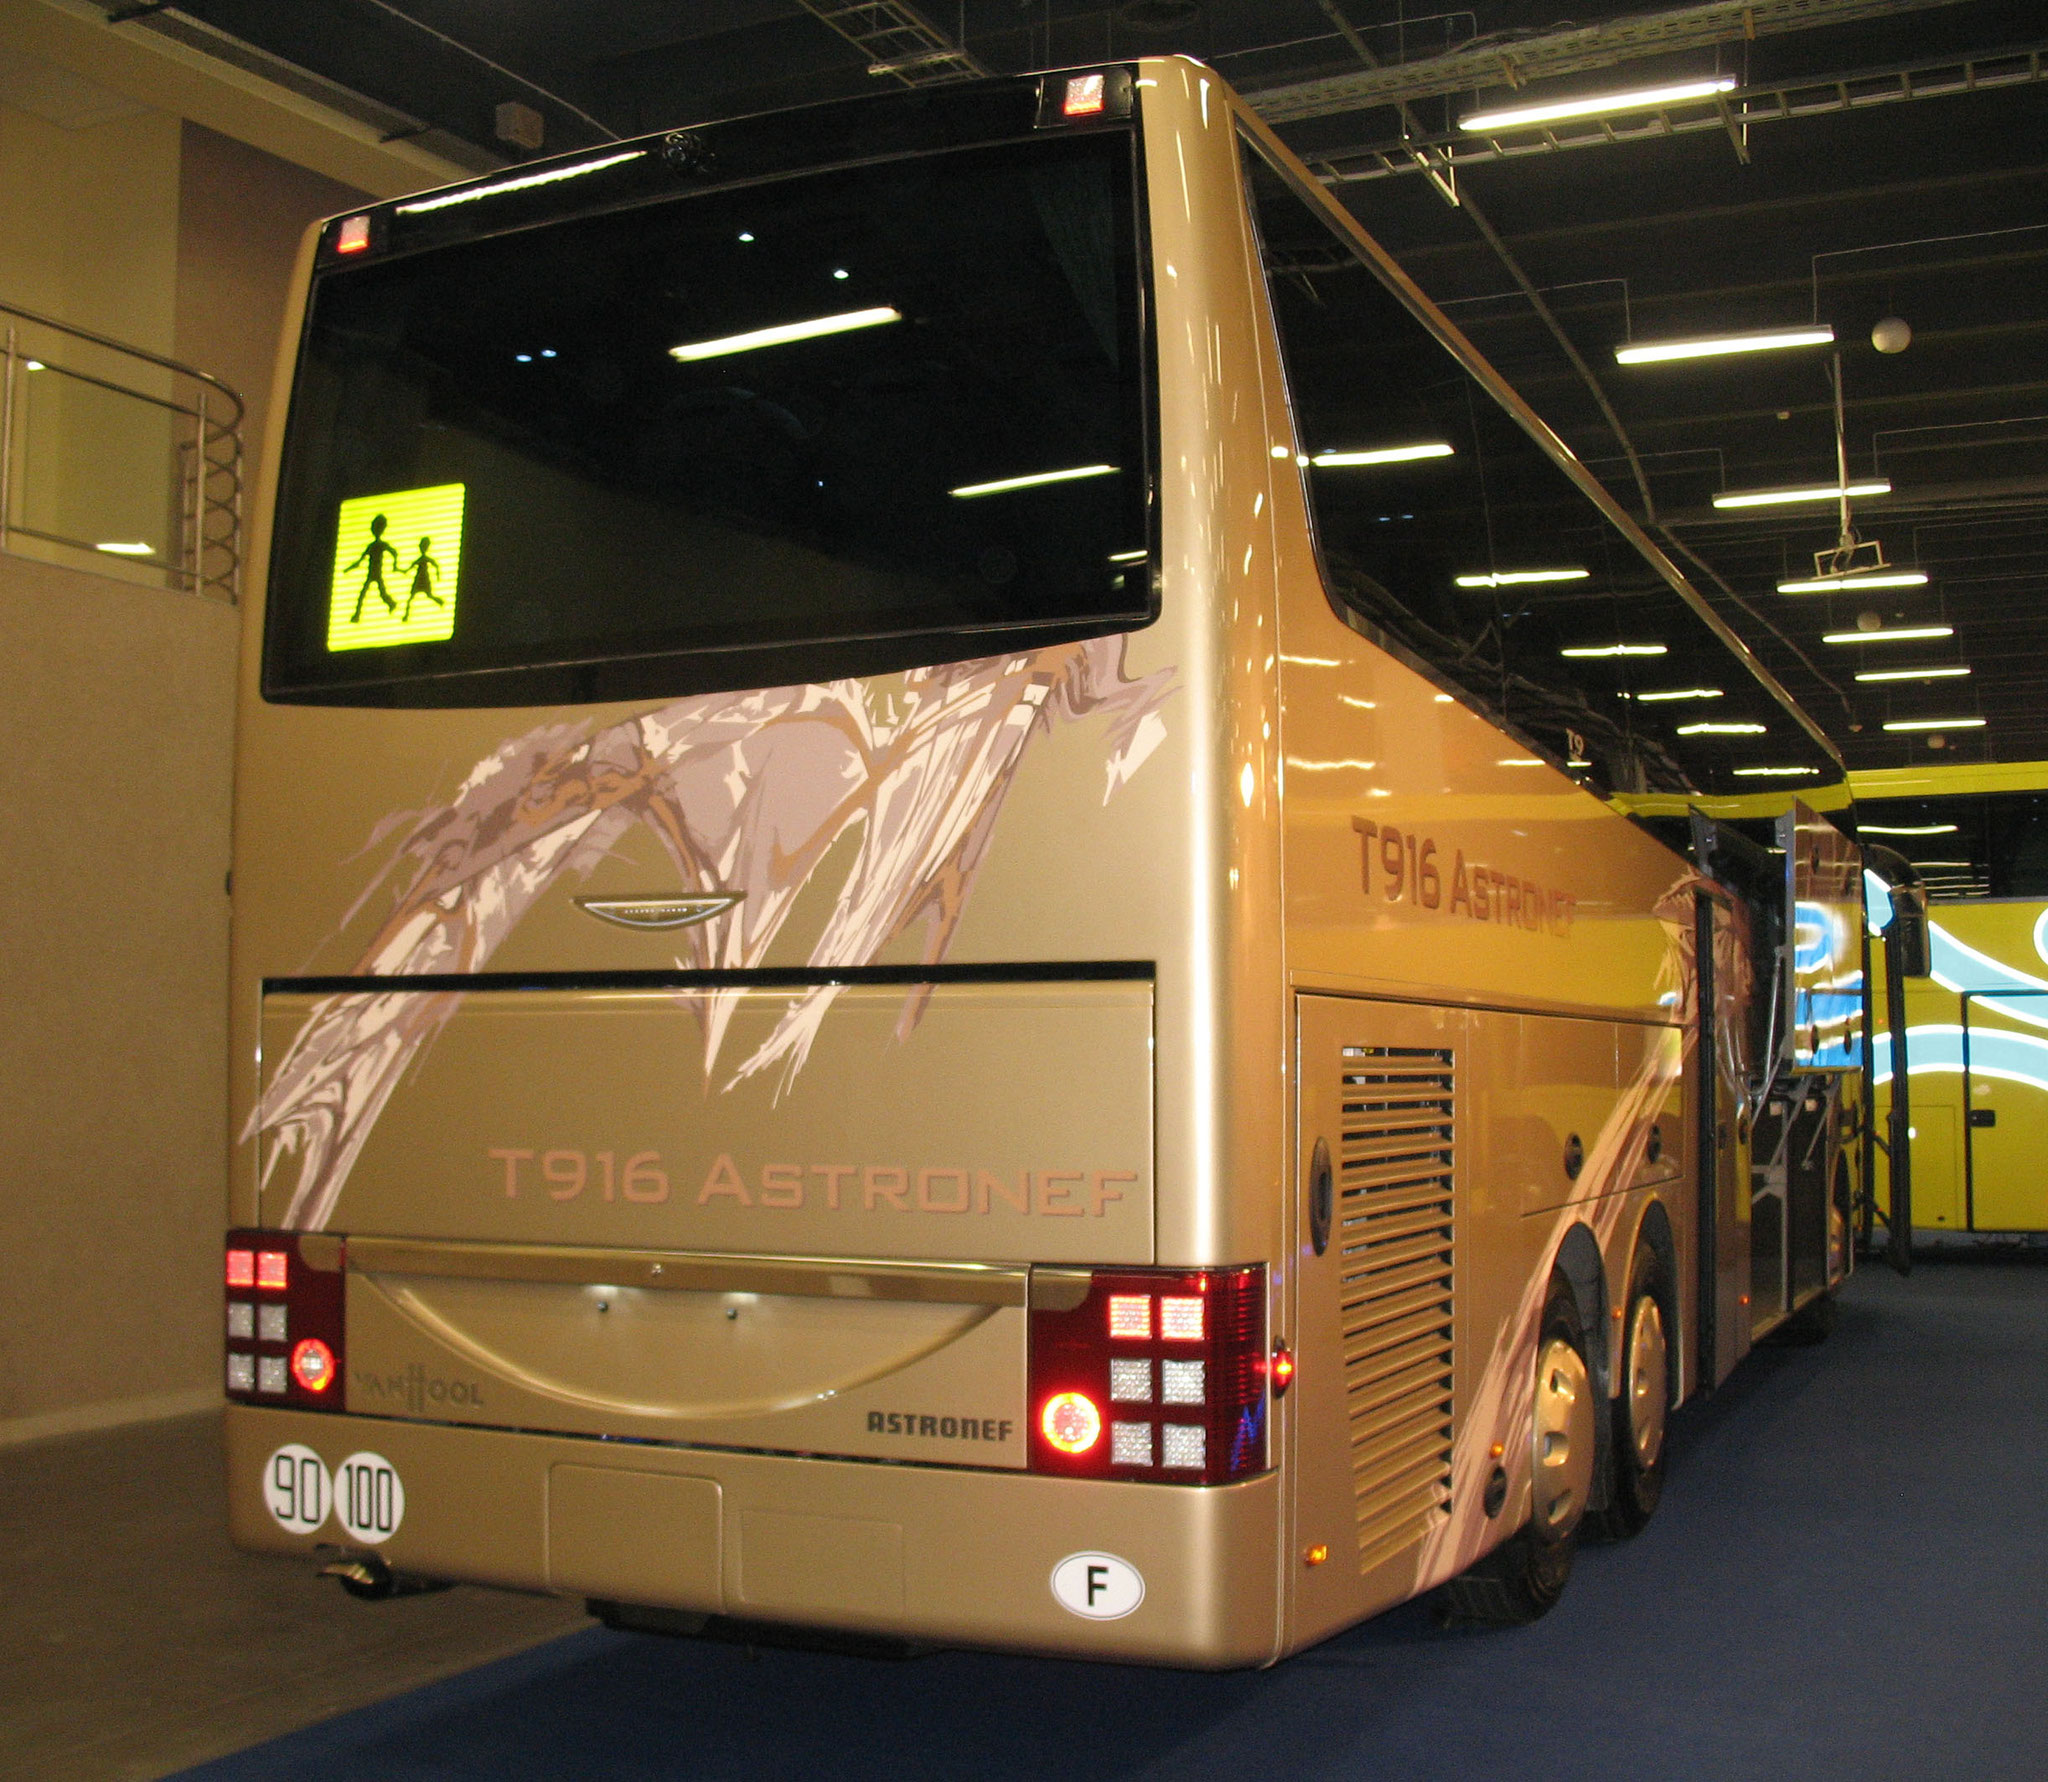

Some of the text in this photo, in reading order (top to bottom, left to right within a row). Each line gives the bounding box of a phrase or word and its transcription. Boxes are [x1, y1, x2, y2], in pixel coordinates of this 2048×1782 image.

[1351, 815, 1441, 910] T916
[488, 1149, 1138, 1218] T916 ASTRONEF
[867, 1411, 1013, 1441] ASTRONEF
[275, 1455, 321, 1524] 90
[345, 1463, 393, 1532] 100
[1087, 1565, 1108, 1607] F
